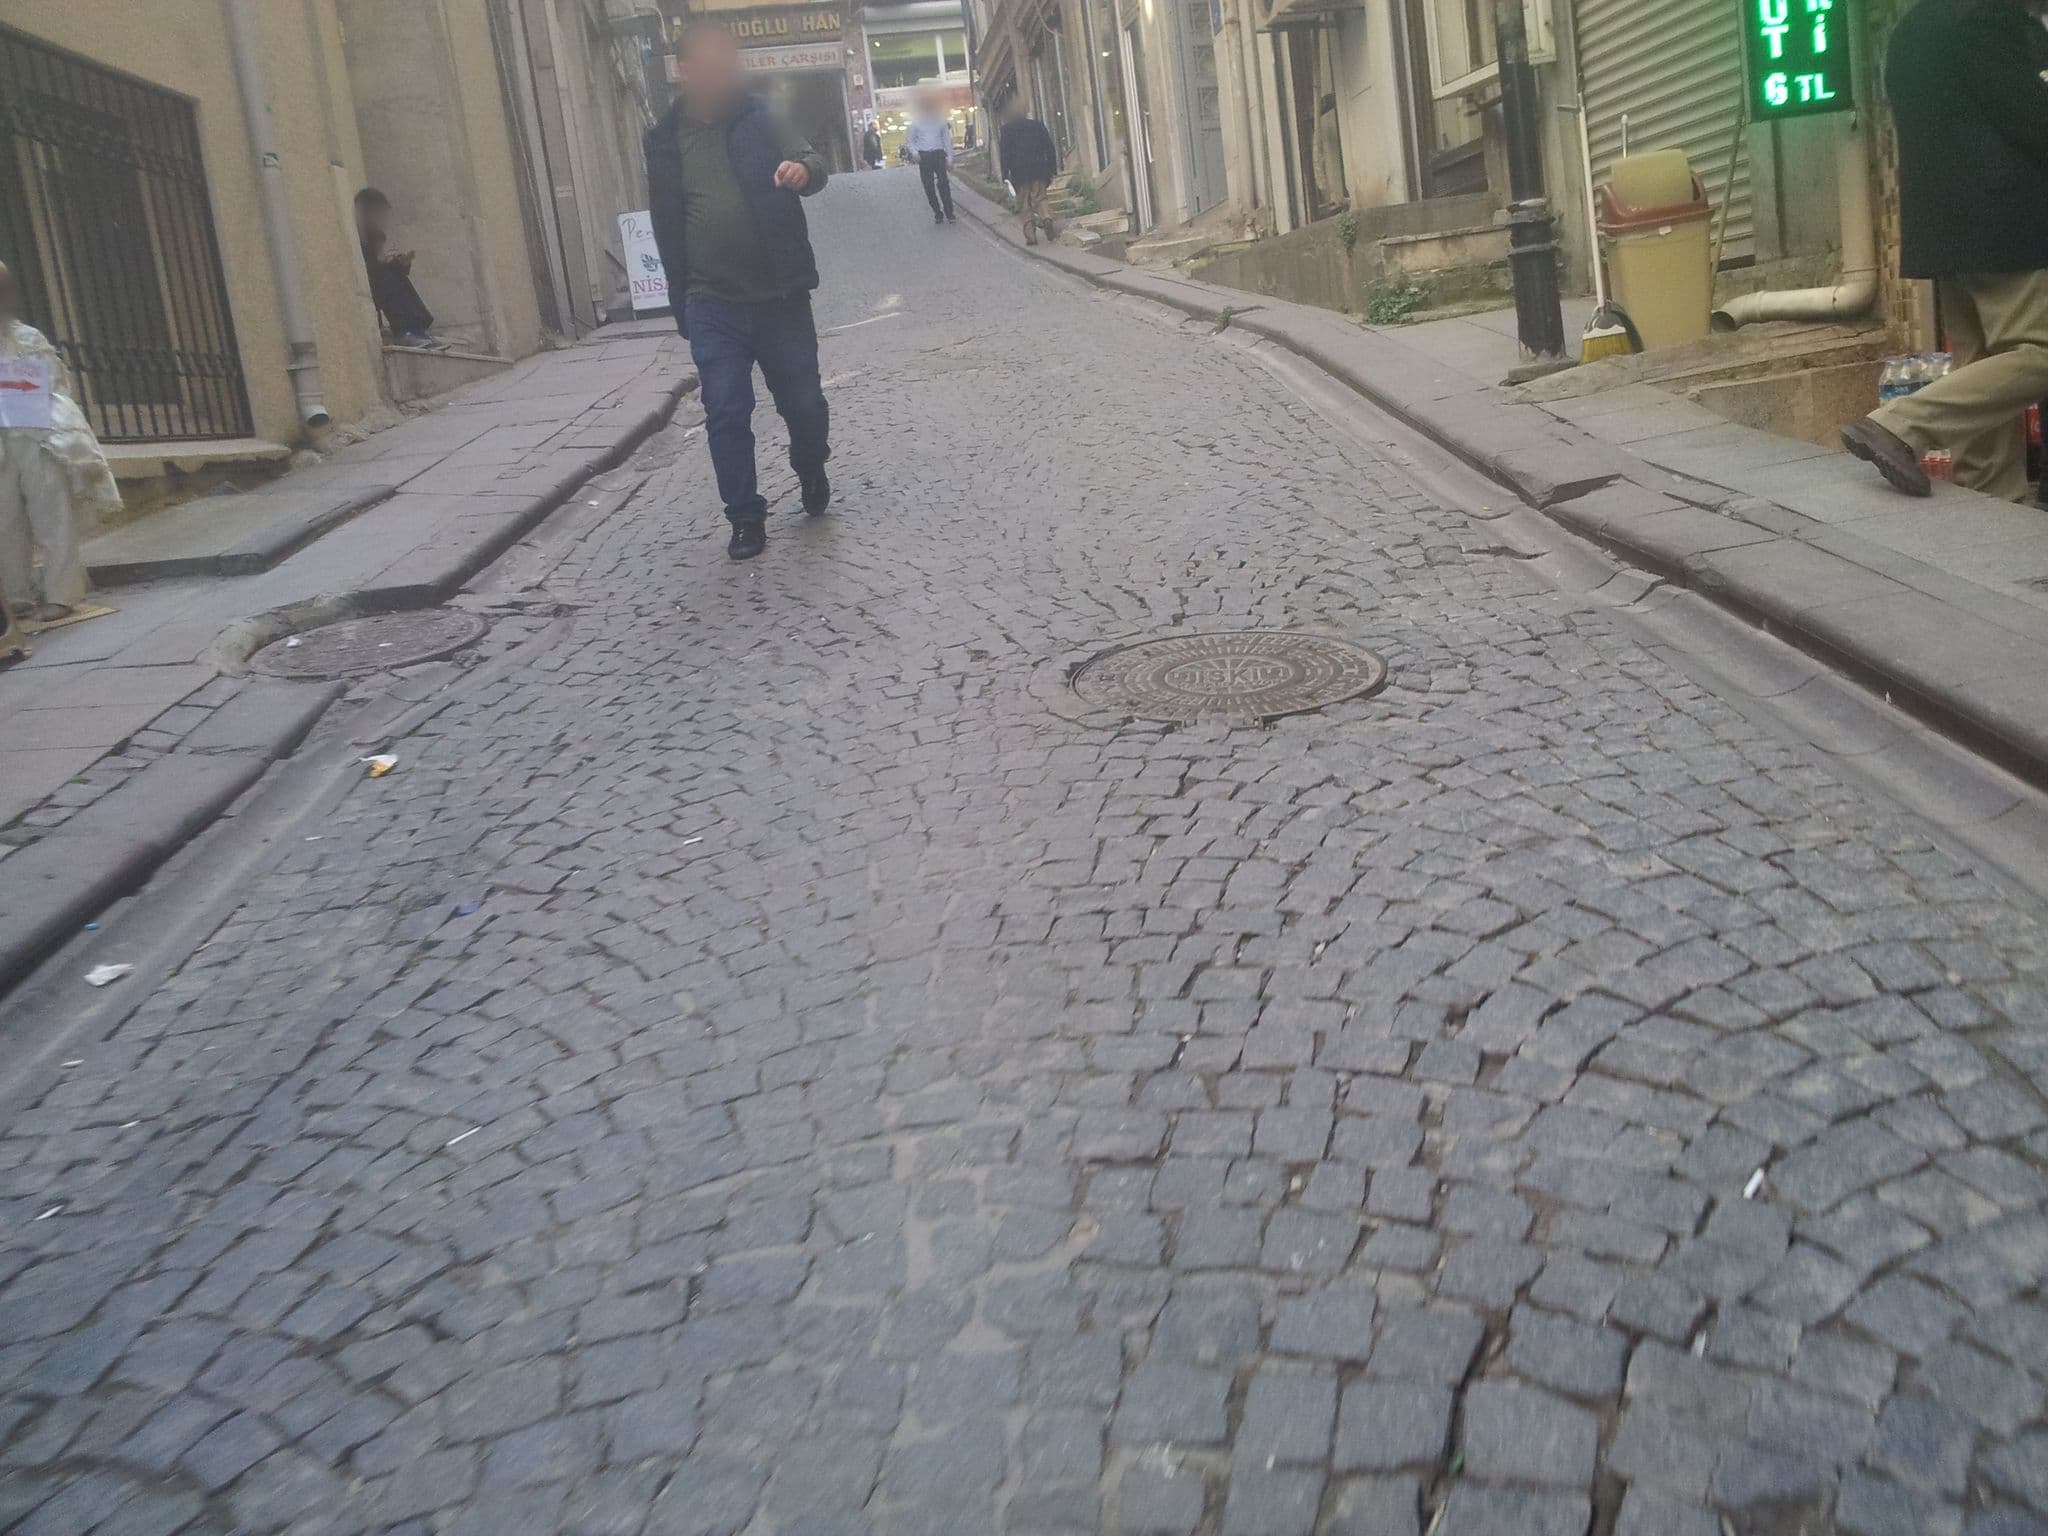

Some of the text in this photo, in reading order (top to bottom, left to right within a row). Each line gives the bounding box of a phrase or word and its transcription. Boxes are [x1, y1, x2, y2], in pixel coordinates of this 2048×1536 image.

[801, 13, 842, 31] HAN
[1764, 71, 1836, 106] 6 TL
